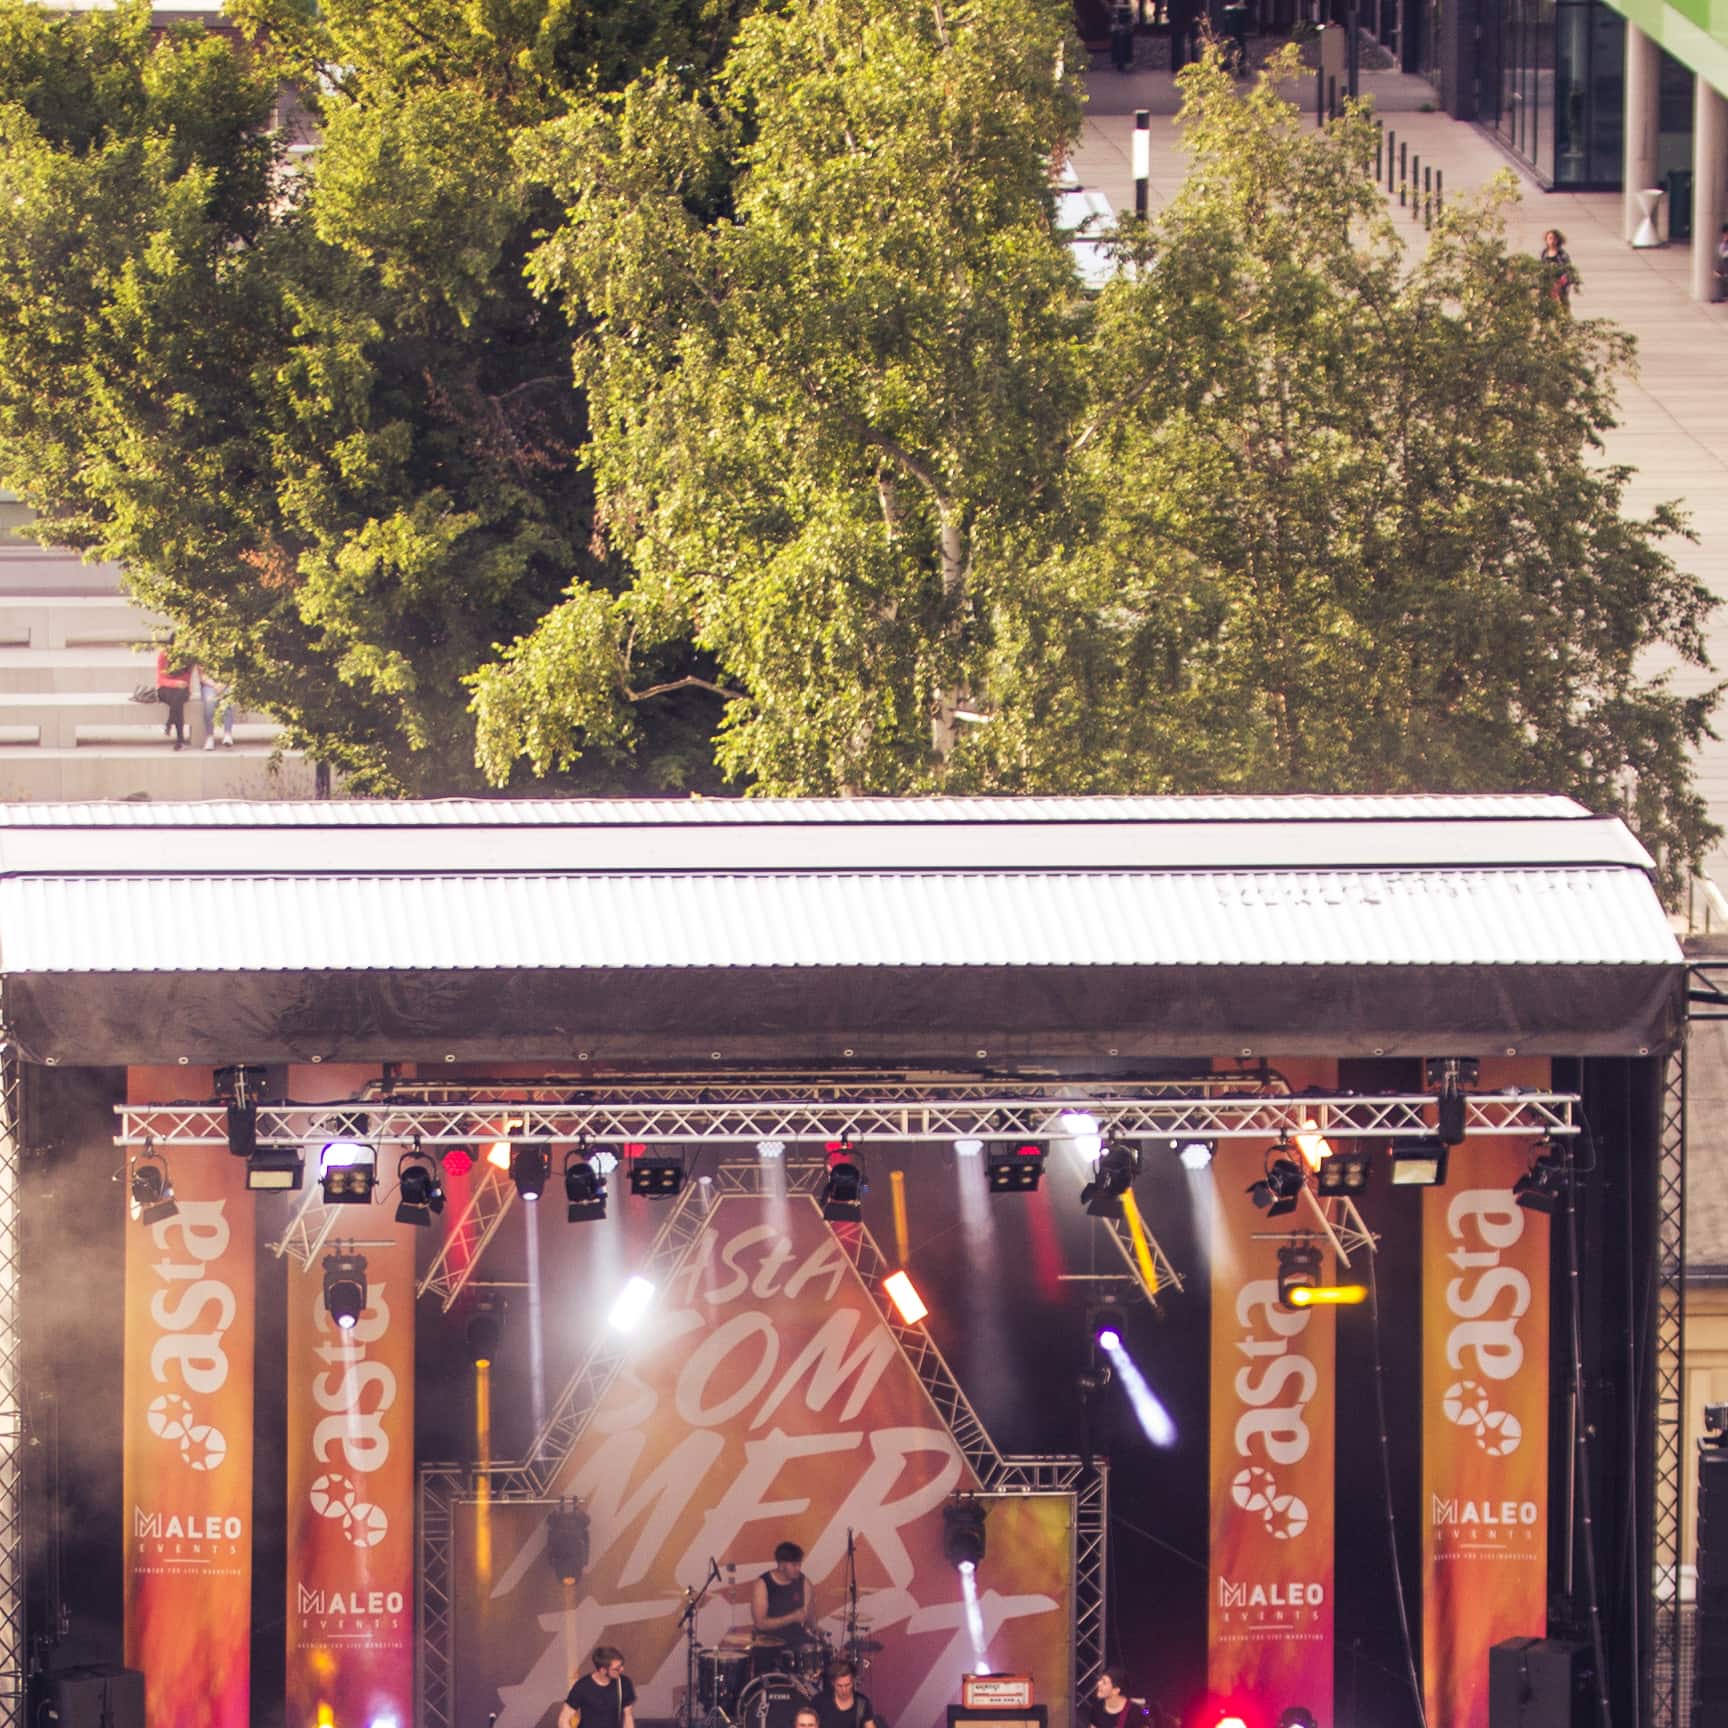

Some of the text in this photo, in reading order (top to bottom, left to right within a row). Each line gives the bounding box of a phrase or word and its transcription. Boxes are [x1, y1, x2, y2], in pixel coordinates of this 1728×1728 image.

[134, 1504, 242, 1539] MALEO
[1432, 1492, 1537, 1525] MALEO
[297, 1581, 403, 1615] MALEO
[1217, 1575, 1324, 1608] MALEO
